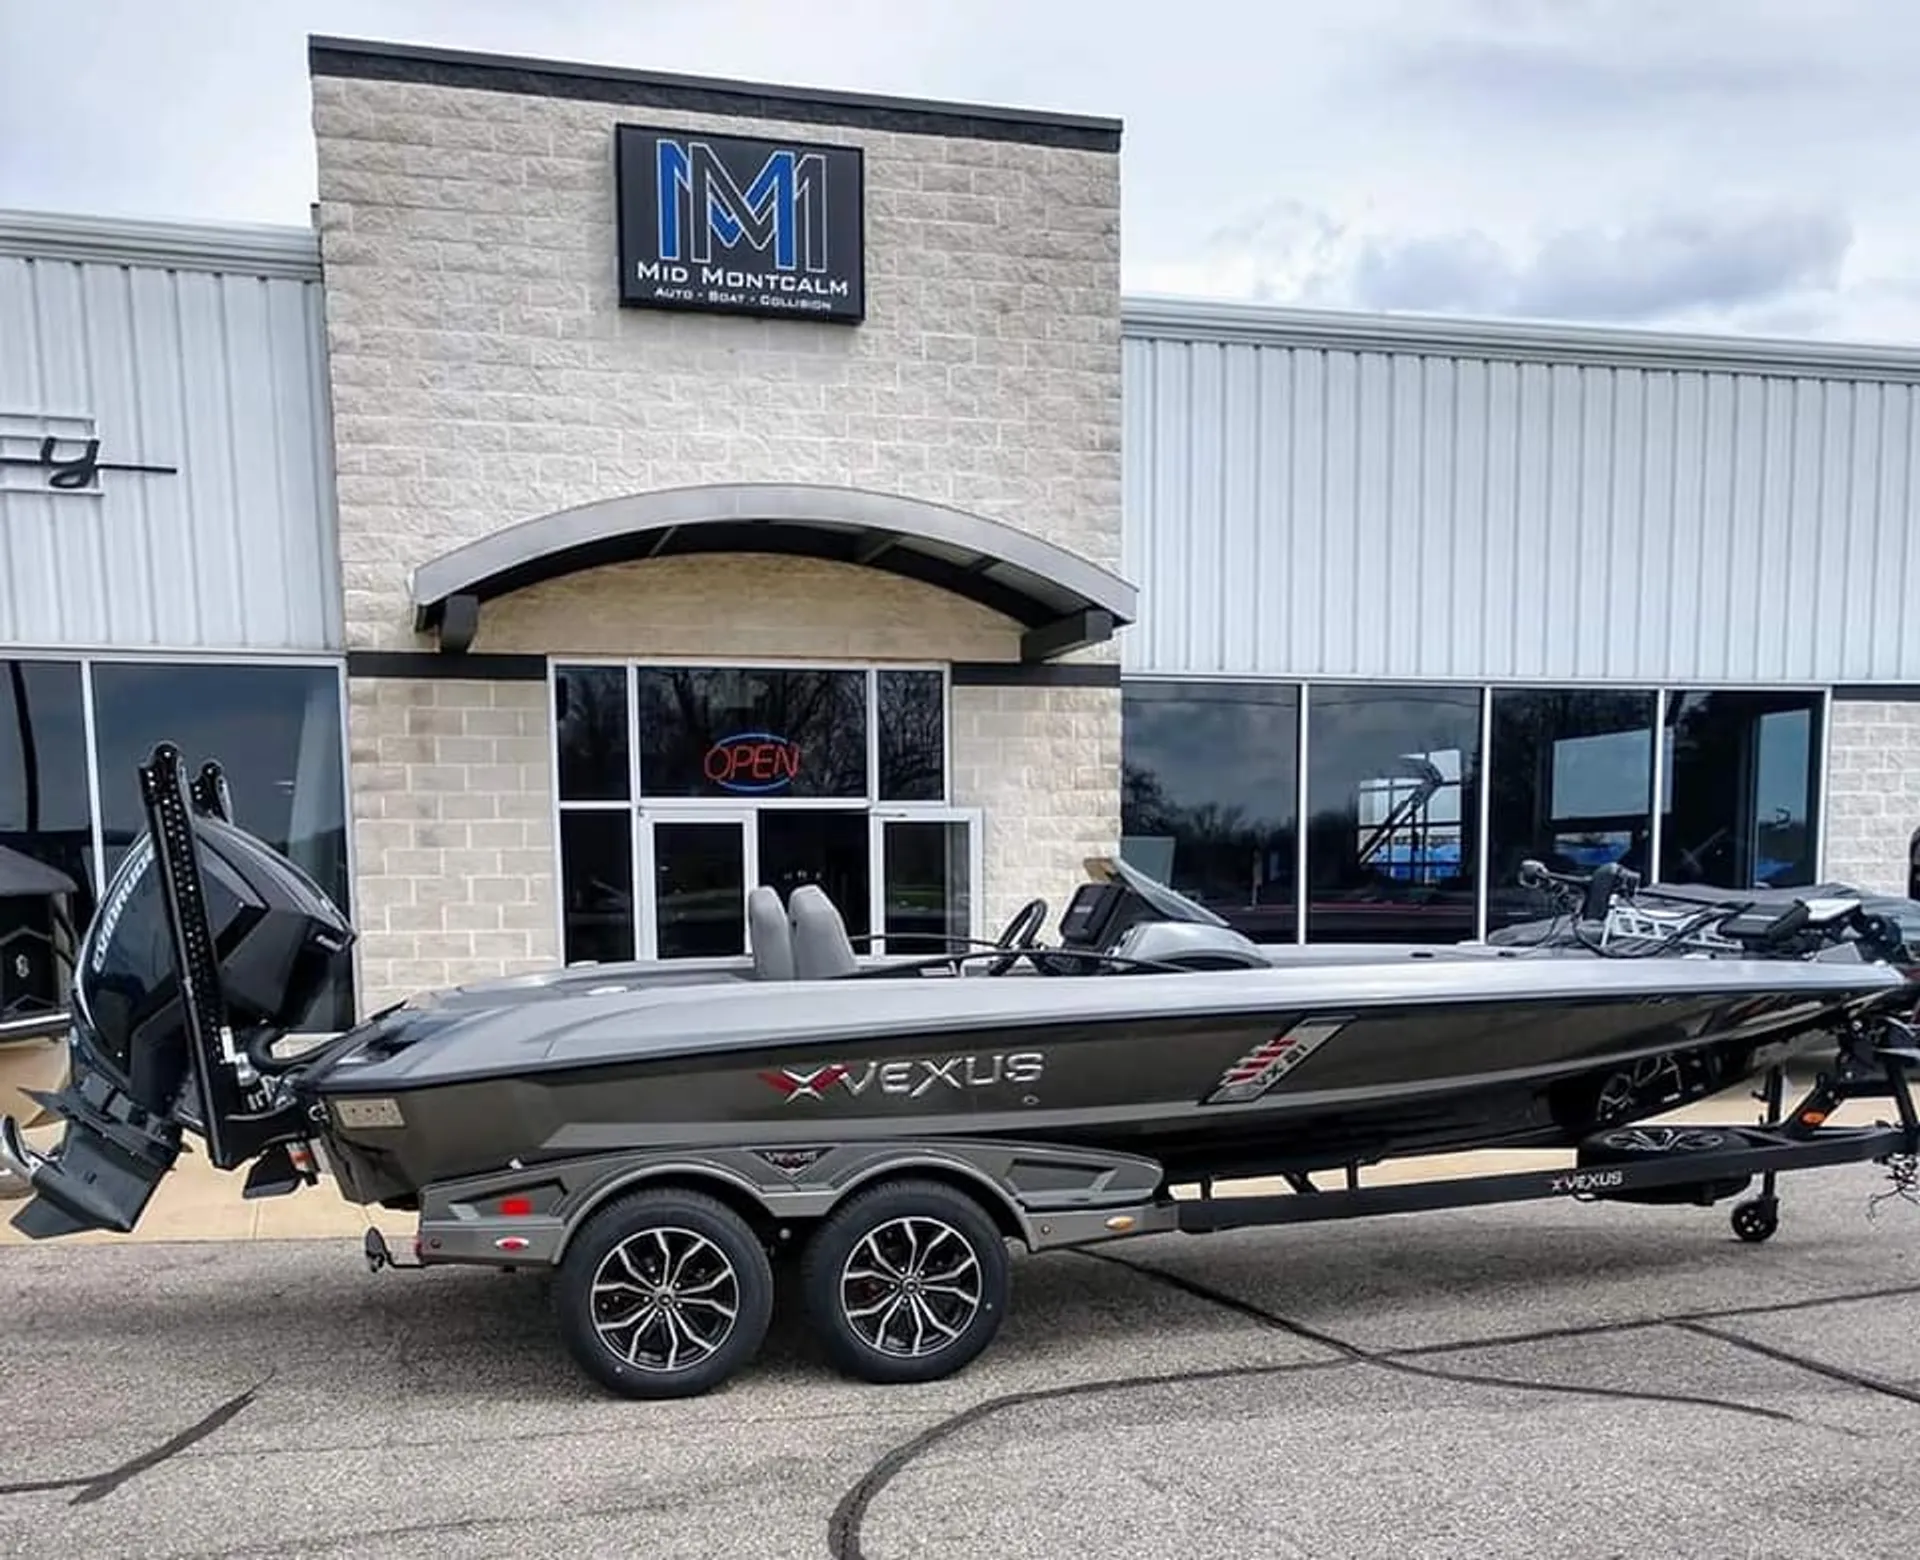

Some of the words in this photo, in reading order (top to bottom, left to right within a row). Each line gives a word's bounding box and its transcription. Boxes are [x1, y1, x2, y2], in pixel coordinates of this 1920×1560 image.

[637, 261, 688, 283] MID
[702, 266, 848, 297] MONTCALM
[655, 287, 693, 300] AUTO
[708, 290, 745, 303] BOAT
[760, 294, 832, 311] COLLISION
[704, 742, 800, 780] OPEN
[838, 1053, 1044, 1098] VEXUS
[1566, 1171, 1623, 1190] VEXUS
